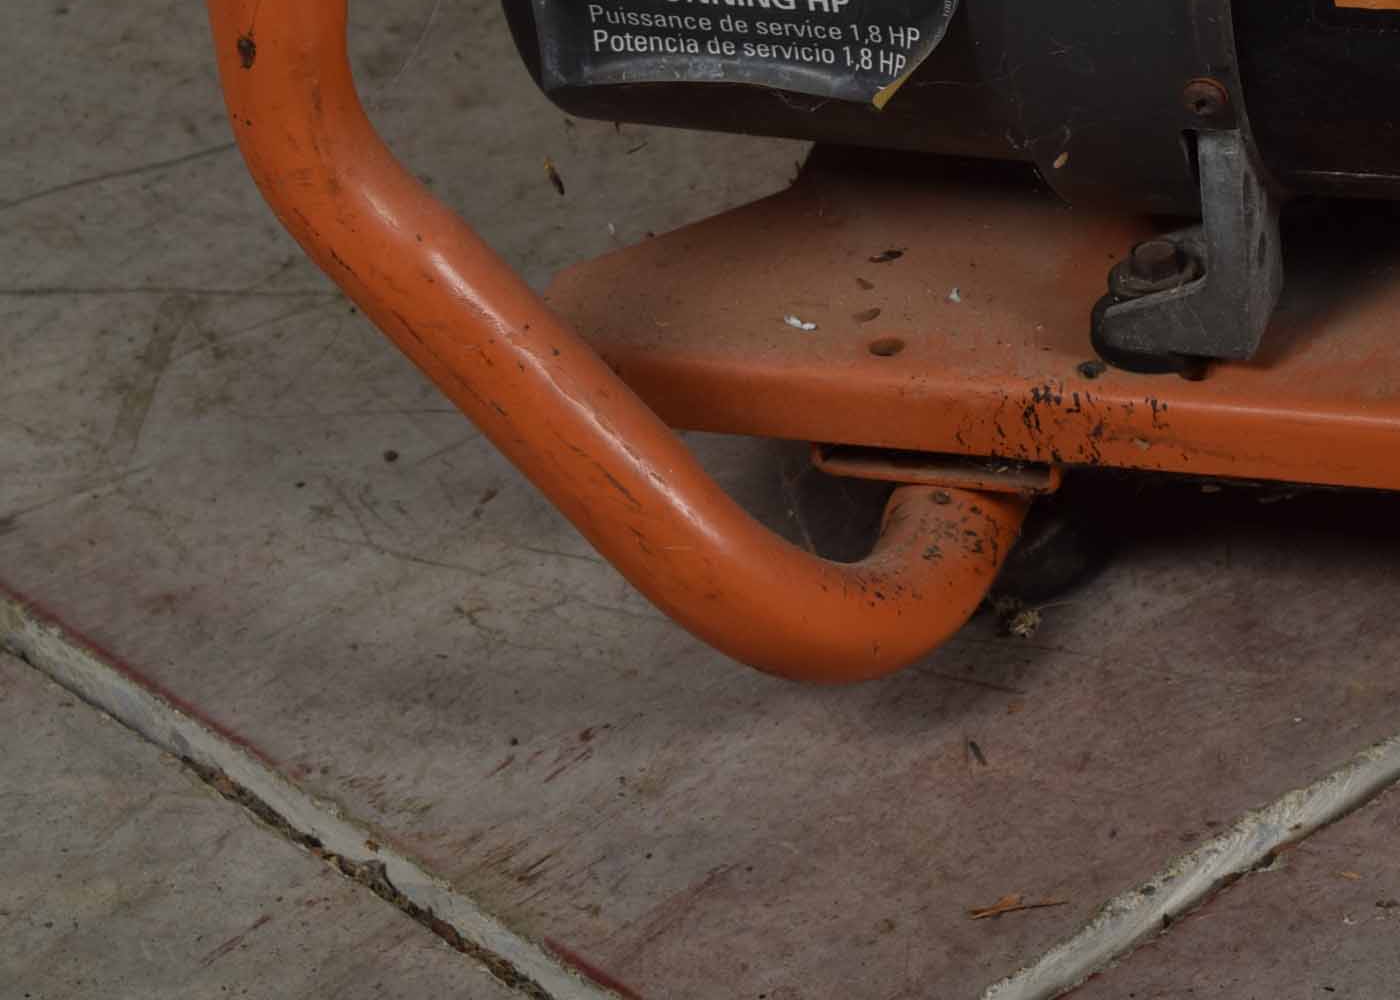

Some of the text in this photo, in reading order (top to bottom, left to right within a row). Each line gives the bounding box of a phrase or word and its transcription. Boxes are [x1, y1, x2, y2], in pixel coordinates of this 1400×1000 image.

[588, 4, 920, 49] Puissance de service 1,8 HP
[593, 30, 906, 77] Potencia de servicio 1,8 HP
